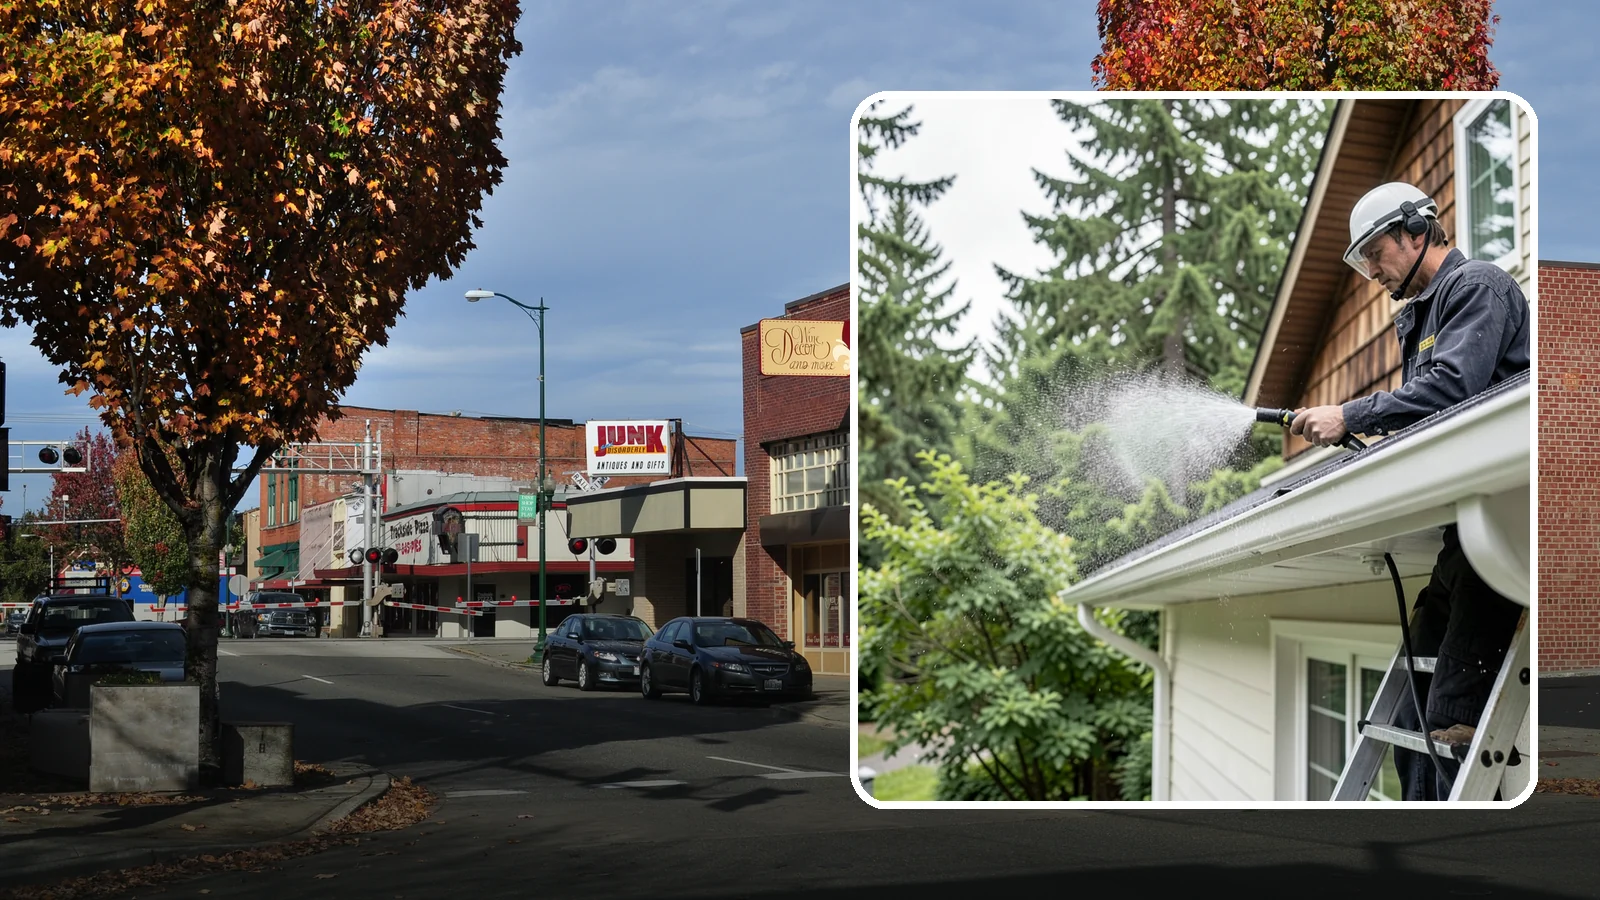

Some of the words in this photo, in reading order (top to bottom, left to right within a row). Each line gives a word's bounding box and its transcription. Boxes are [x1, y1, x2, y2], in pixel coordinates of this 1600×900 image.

[764, 327, 831, 365] Decor
[595, 425, 664, 457] JUNK
[607, 446, 646, 454] DISORDERLY
[597, 461, 628, 470] ANTIQUES
[631, 461, 644, 470] AND
[647, 460, 666, 469] GIFTS
[414, 519, 429, 535] Pizza
